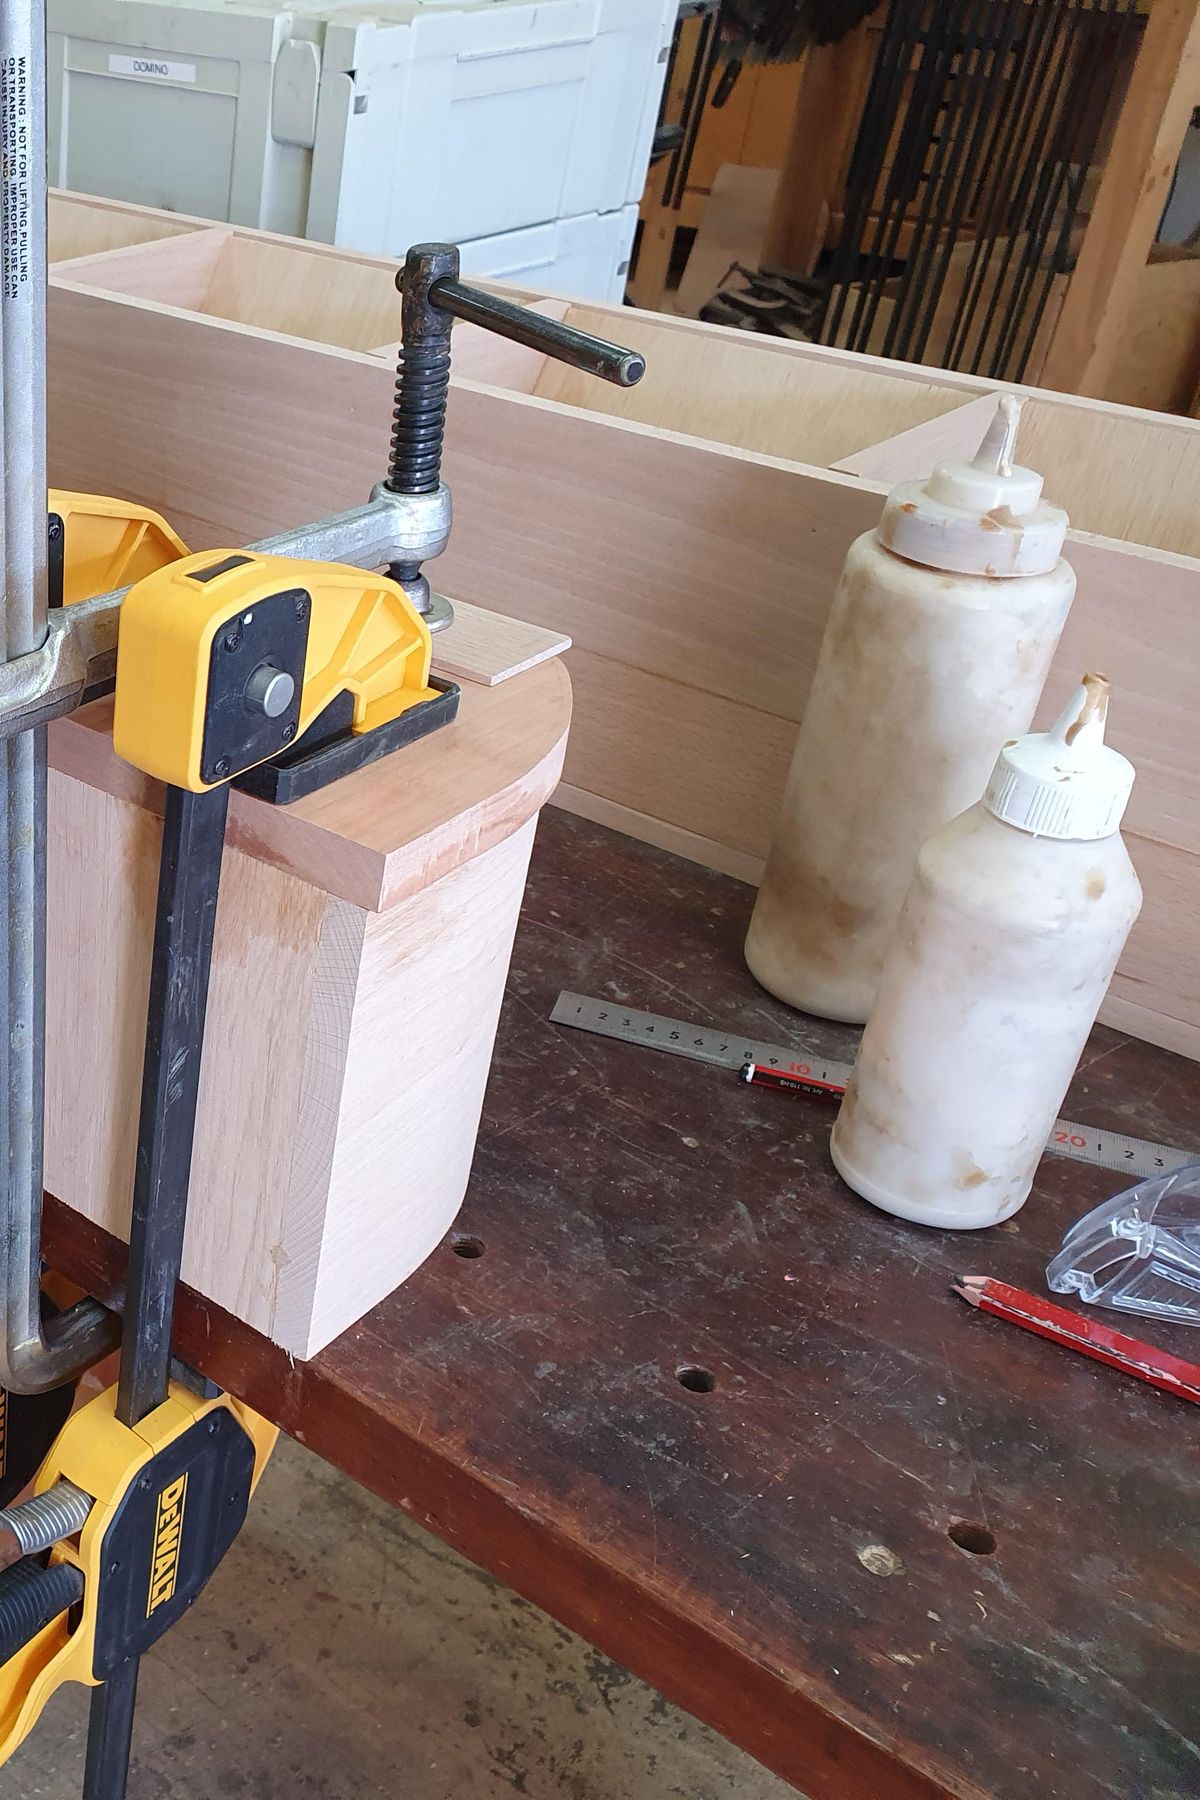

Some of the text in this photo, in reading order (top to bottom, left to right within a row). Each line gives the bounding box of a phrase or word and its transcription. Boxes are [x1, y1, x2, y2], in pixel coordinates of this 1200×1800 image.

[8, 57, 16, 76] OR
[18, 56, 26, 116] WARNING
[132, 60, 168, 76] DOMINO
[18, 126, 26, 150] NOT
[598, 1012, 608, 1020] 2
[669, 1031, 680, 1040] 5
[694, 1038, 704, 1046] 6
[744, 1051, 754, 1059] 8
[790, 1062, 812, 1076] 10
[1054, 1131, 1087, 1149] 20
[1124, 1150, 1136, 1160] 2
[1154, 1158, 1164, 1167] 3
[150, 1474, 186, 1613] DEWALT
